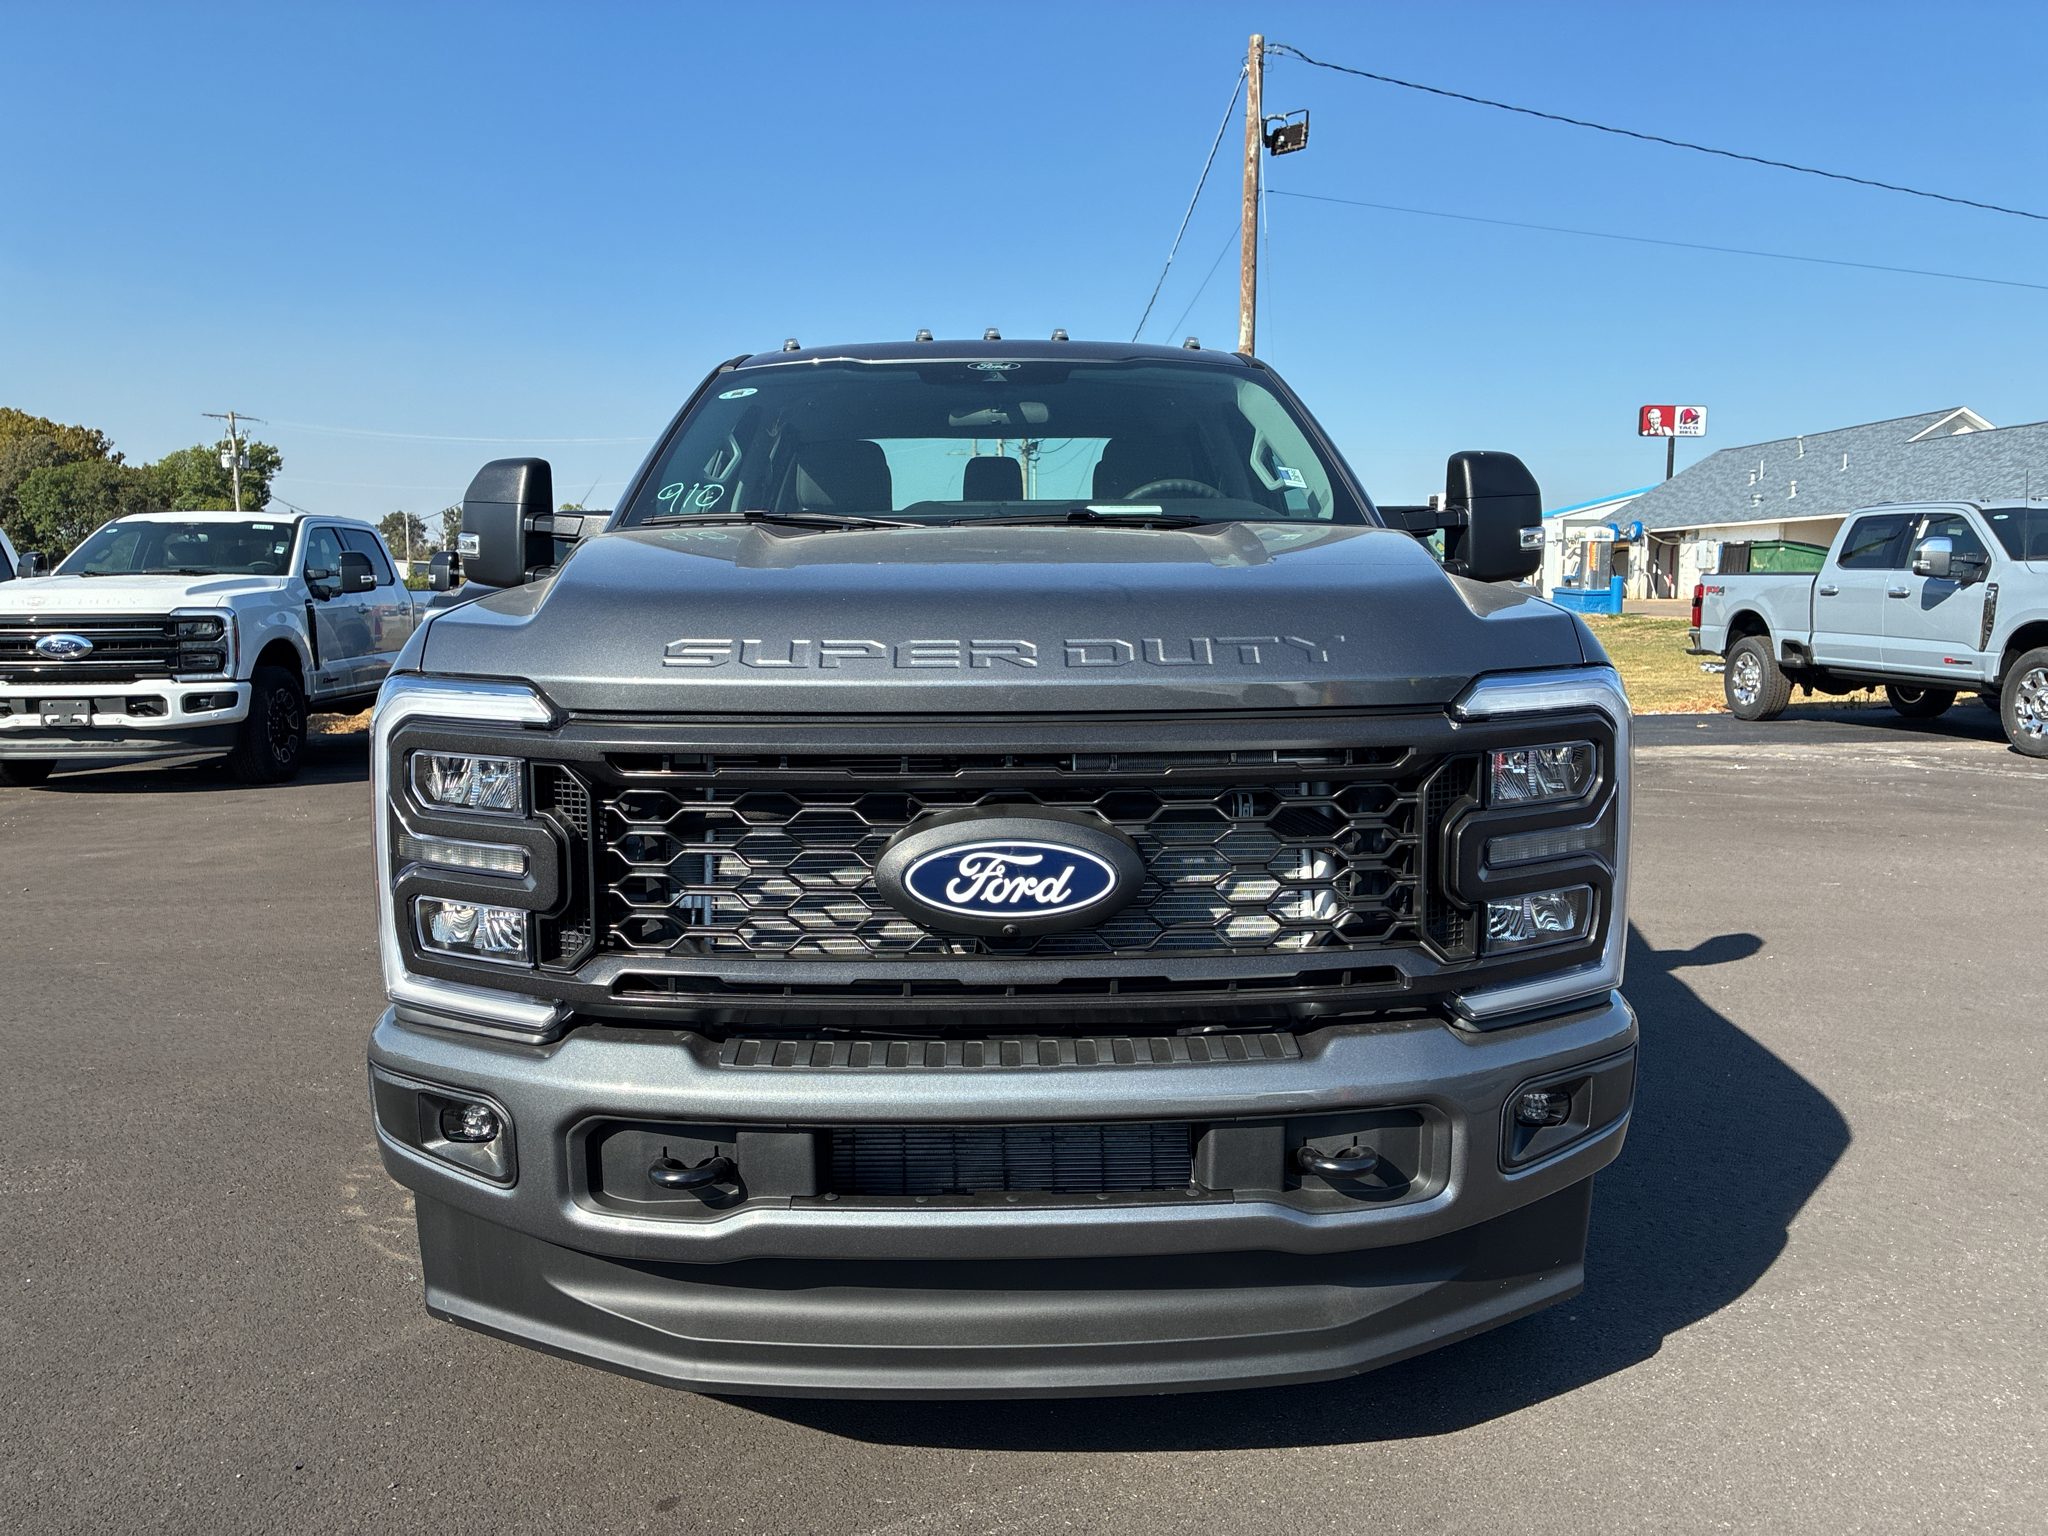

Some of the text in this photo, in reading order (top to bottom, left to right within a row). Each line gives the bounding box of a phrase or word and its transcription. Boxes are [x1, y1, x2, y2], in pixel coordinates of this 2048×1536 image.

[49, 641, 76, 652] Ford
[662, 634, 1346, 669] SUPER DUTY
[946, 851, 1076, 904] Ford
